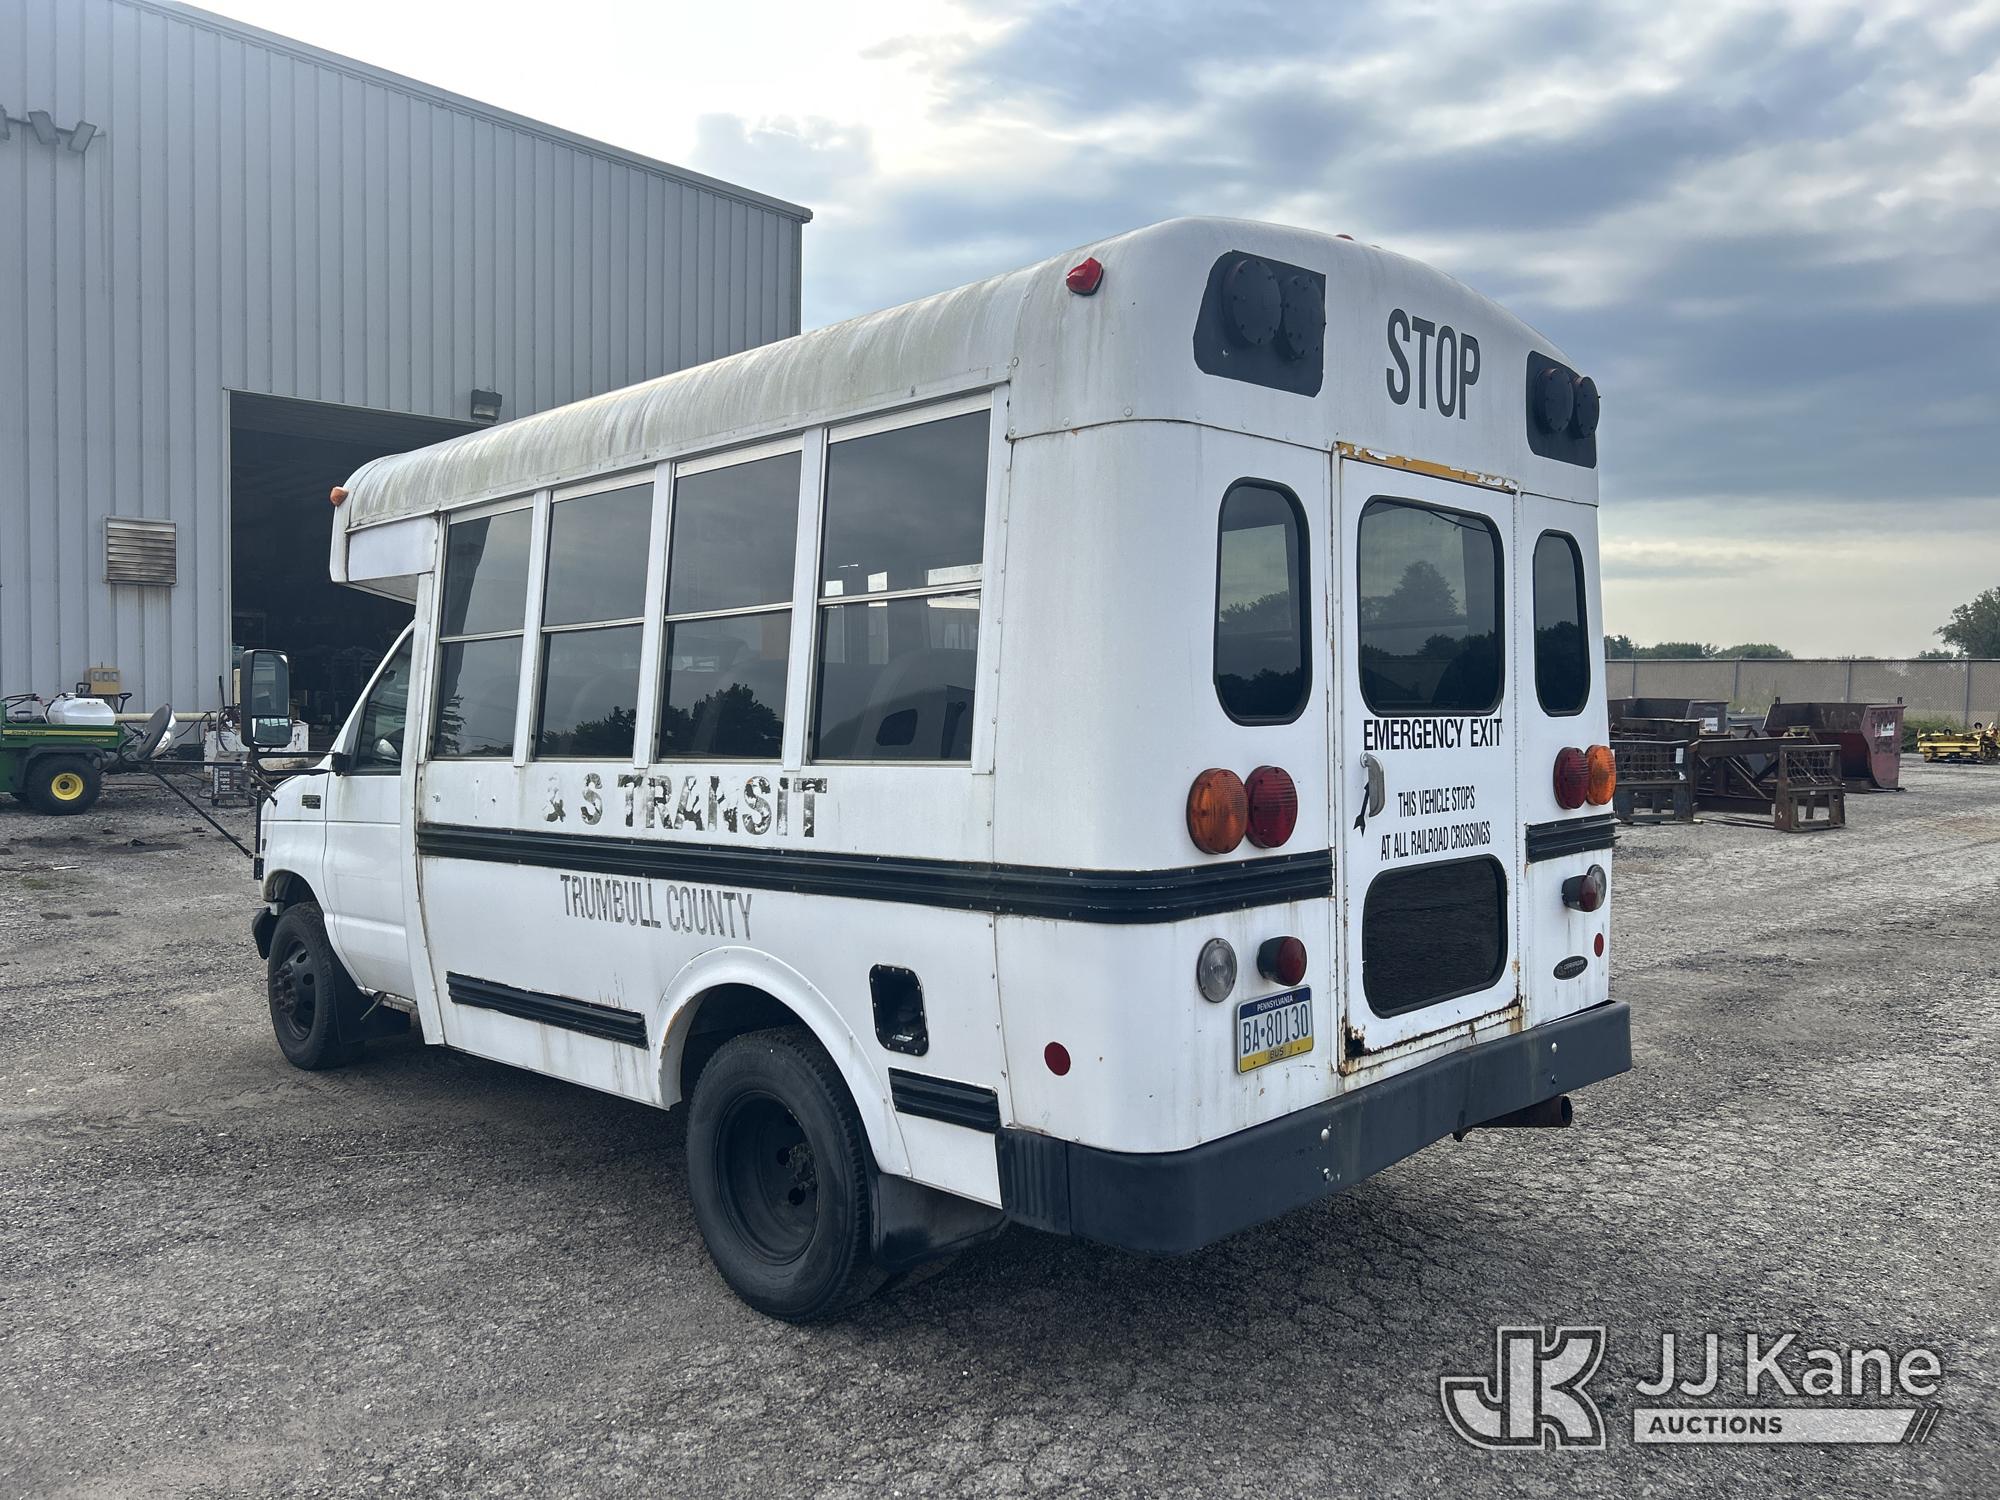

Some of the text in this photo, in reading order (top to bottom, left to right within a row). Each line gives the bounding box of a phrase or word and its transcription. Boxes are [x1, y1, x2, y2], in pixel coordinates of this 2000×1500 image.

[1386, 308, 1480, 420] STOP
[1363, 718, 1503, 751] EMERGENCY EXIT
[617, 774, 828, 838] TRANSIT
[1397, 784, 1475, 818] THIS VEHICLE STOPS
[1380, 820, 1491, 861] AT ALL RAILROAD CROSSINGS
[560, 874, 752, 941] TRUMBULL COUNTY
[1256, 994, 1294, 1012] PENNSYLVANIA
